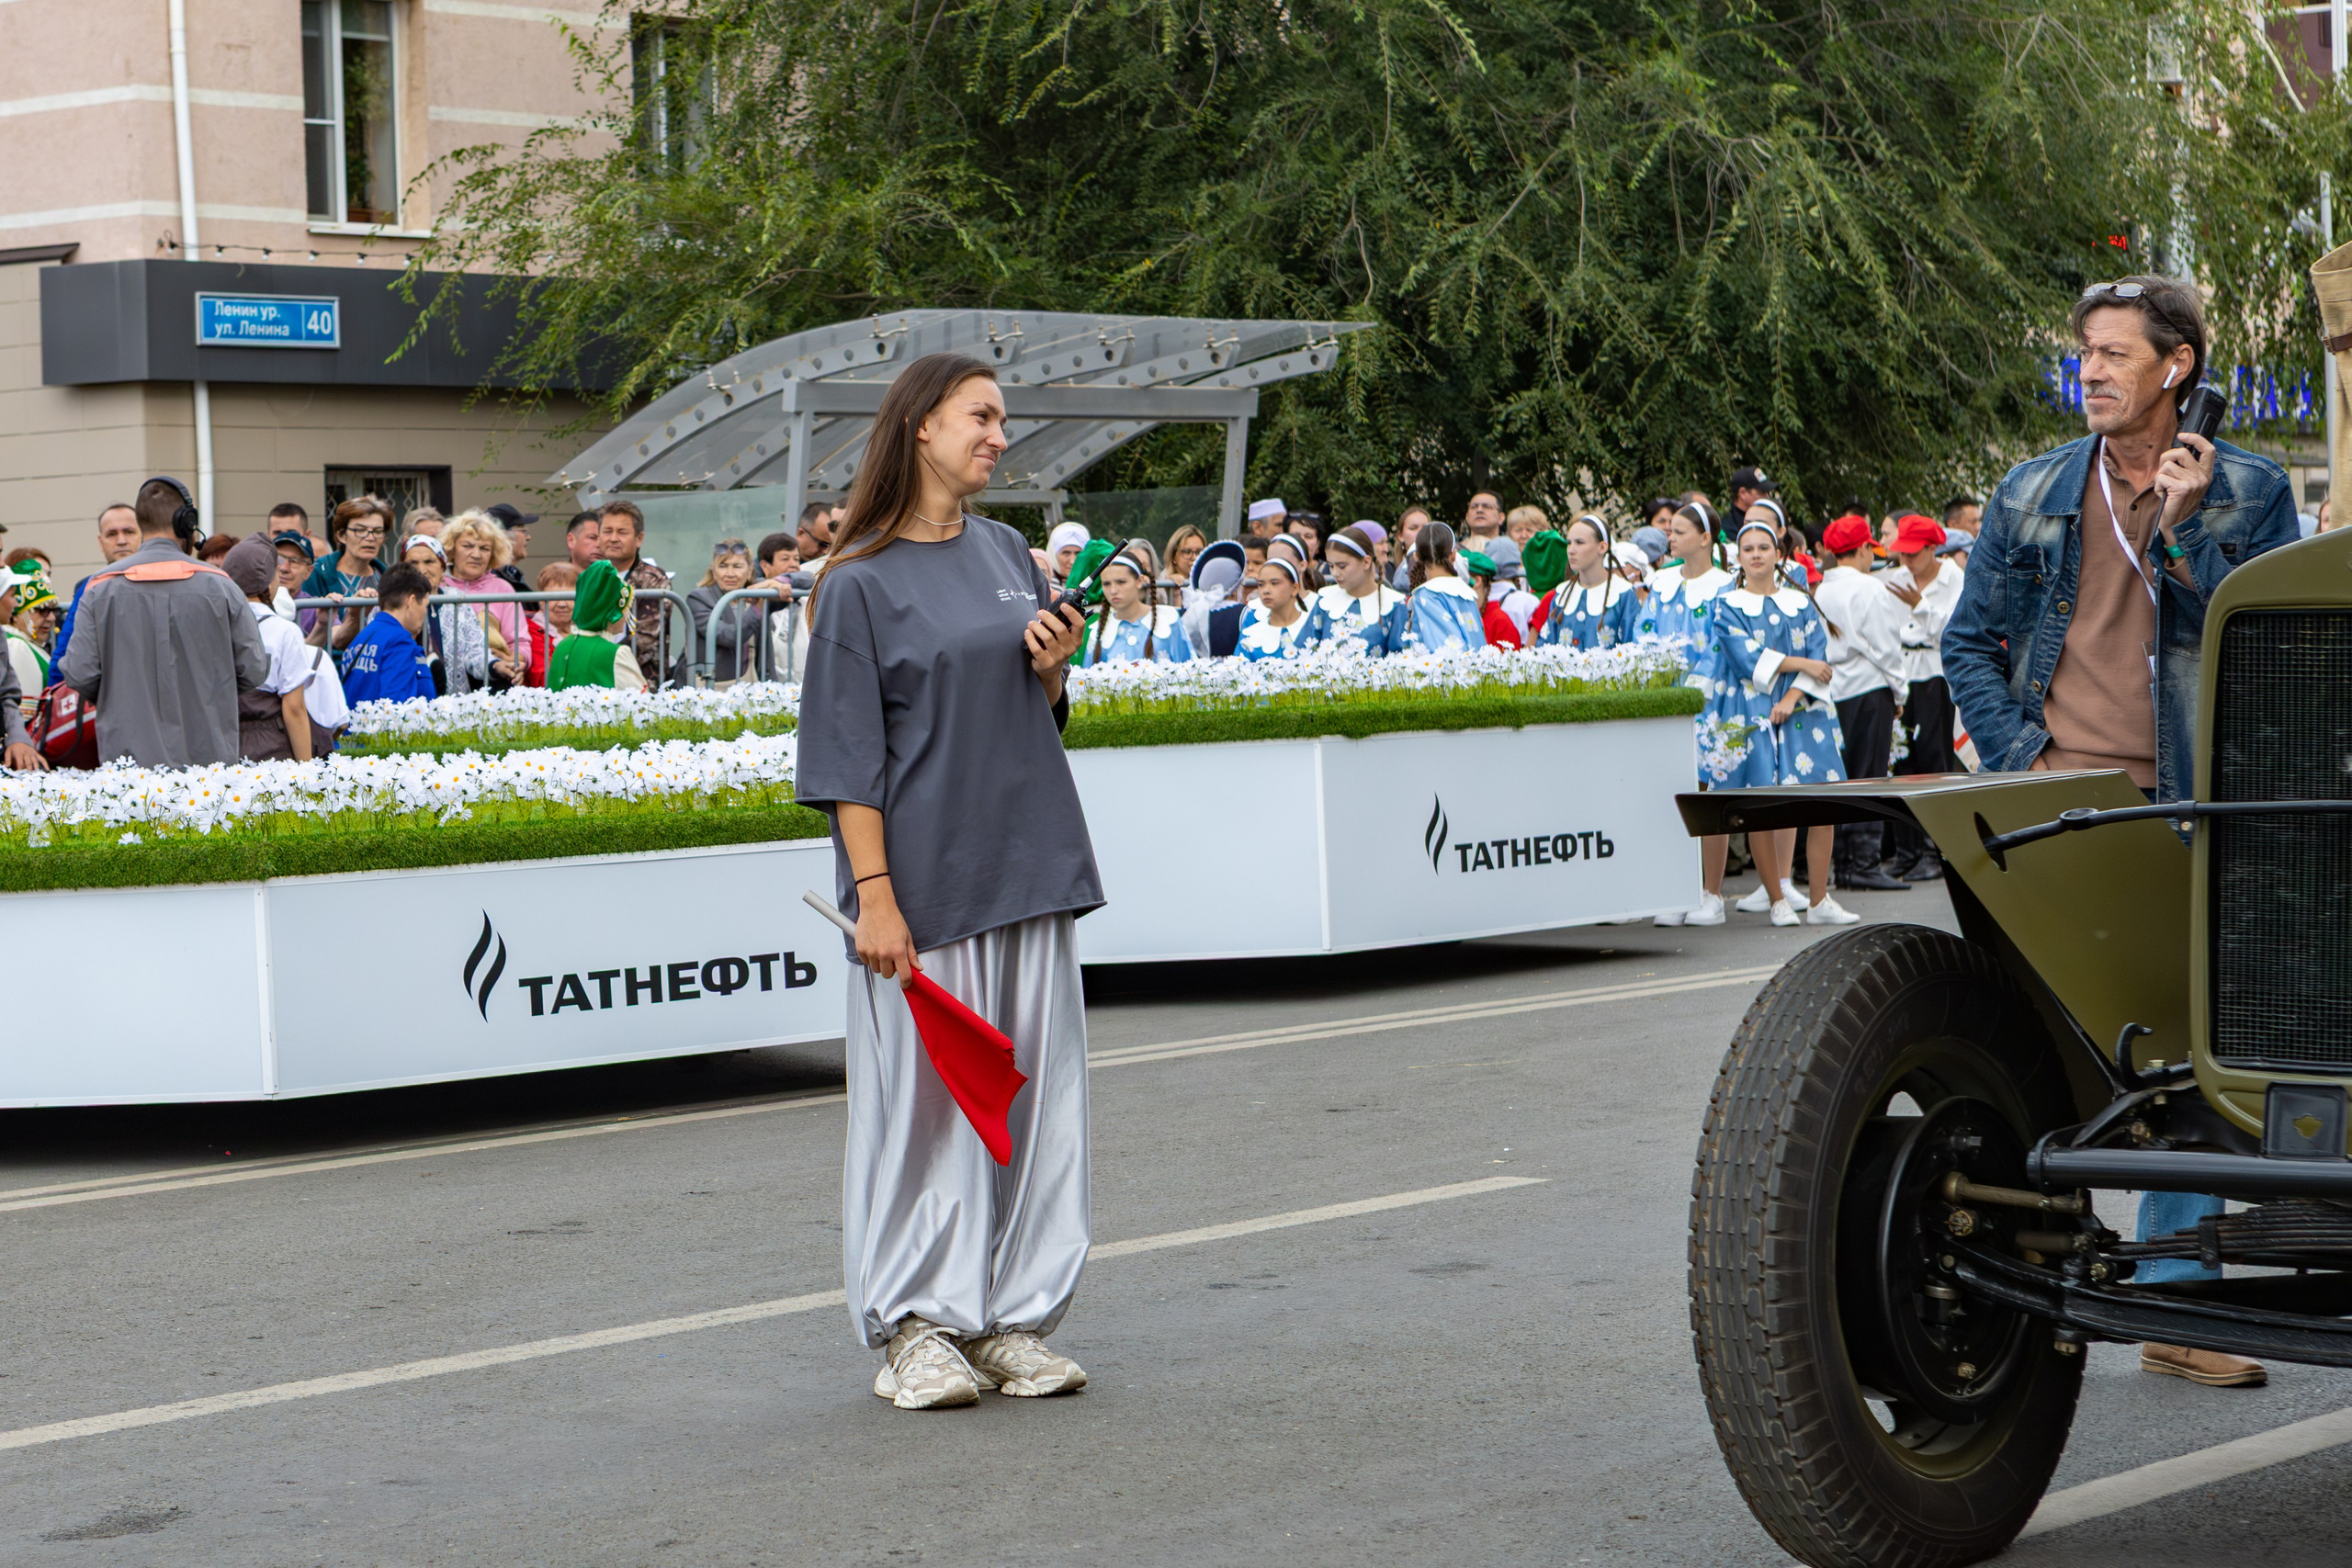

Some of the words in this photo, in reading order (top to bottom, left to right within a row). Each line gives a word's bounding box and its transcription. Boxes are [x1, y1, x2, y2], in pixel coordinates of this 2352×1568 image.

[215, 301, 257, 317] Ленин
[260, 306, 281, 321] ур.
[307, 310, 332, 334] 40
[215, 323, 235, 338] ул.
[239, 321, 289, 336] Ленина
[1454, 830, 1614, 873] ТАТНЕФТЬ
[518, 951, 818, 1017] ТАТНЕФТЬ
